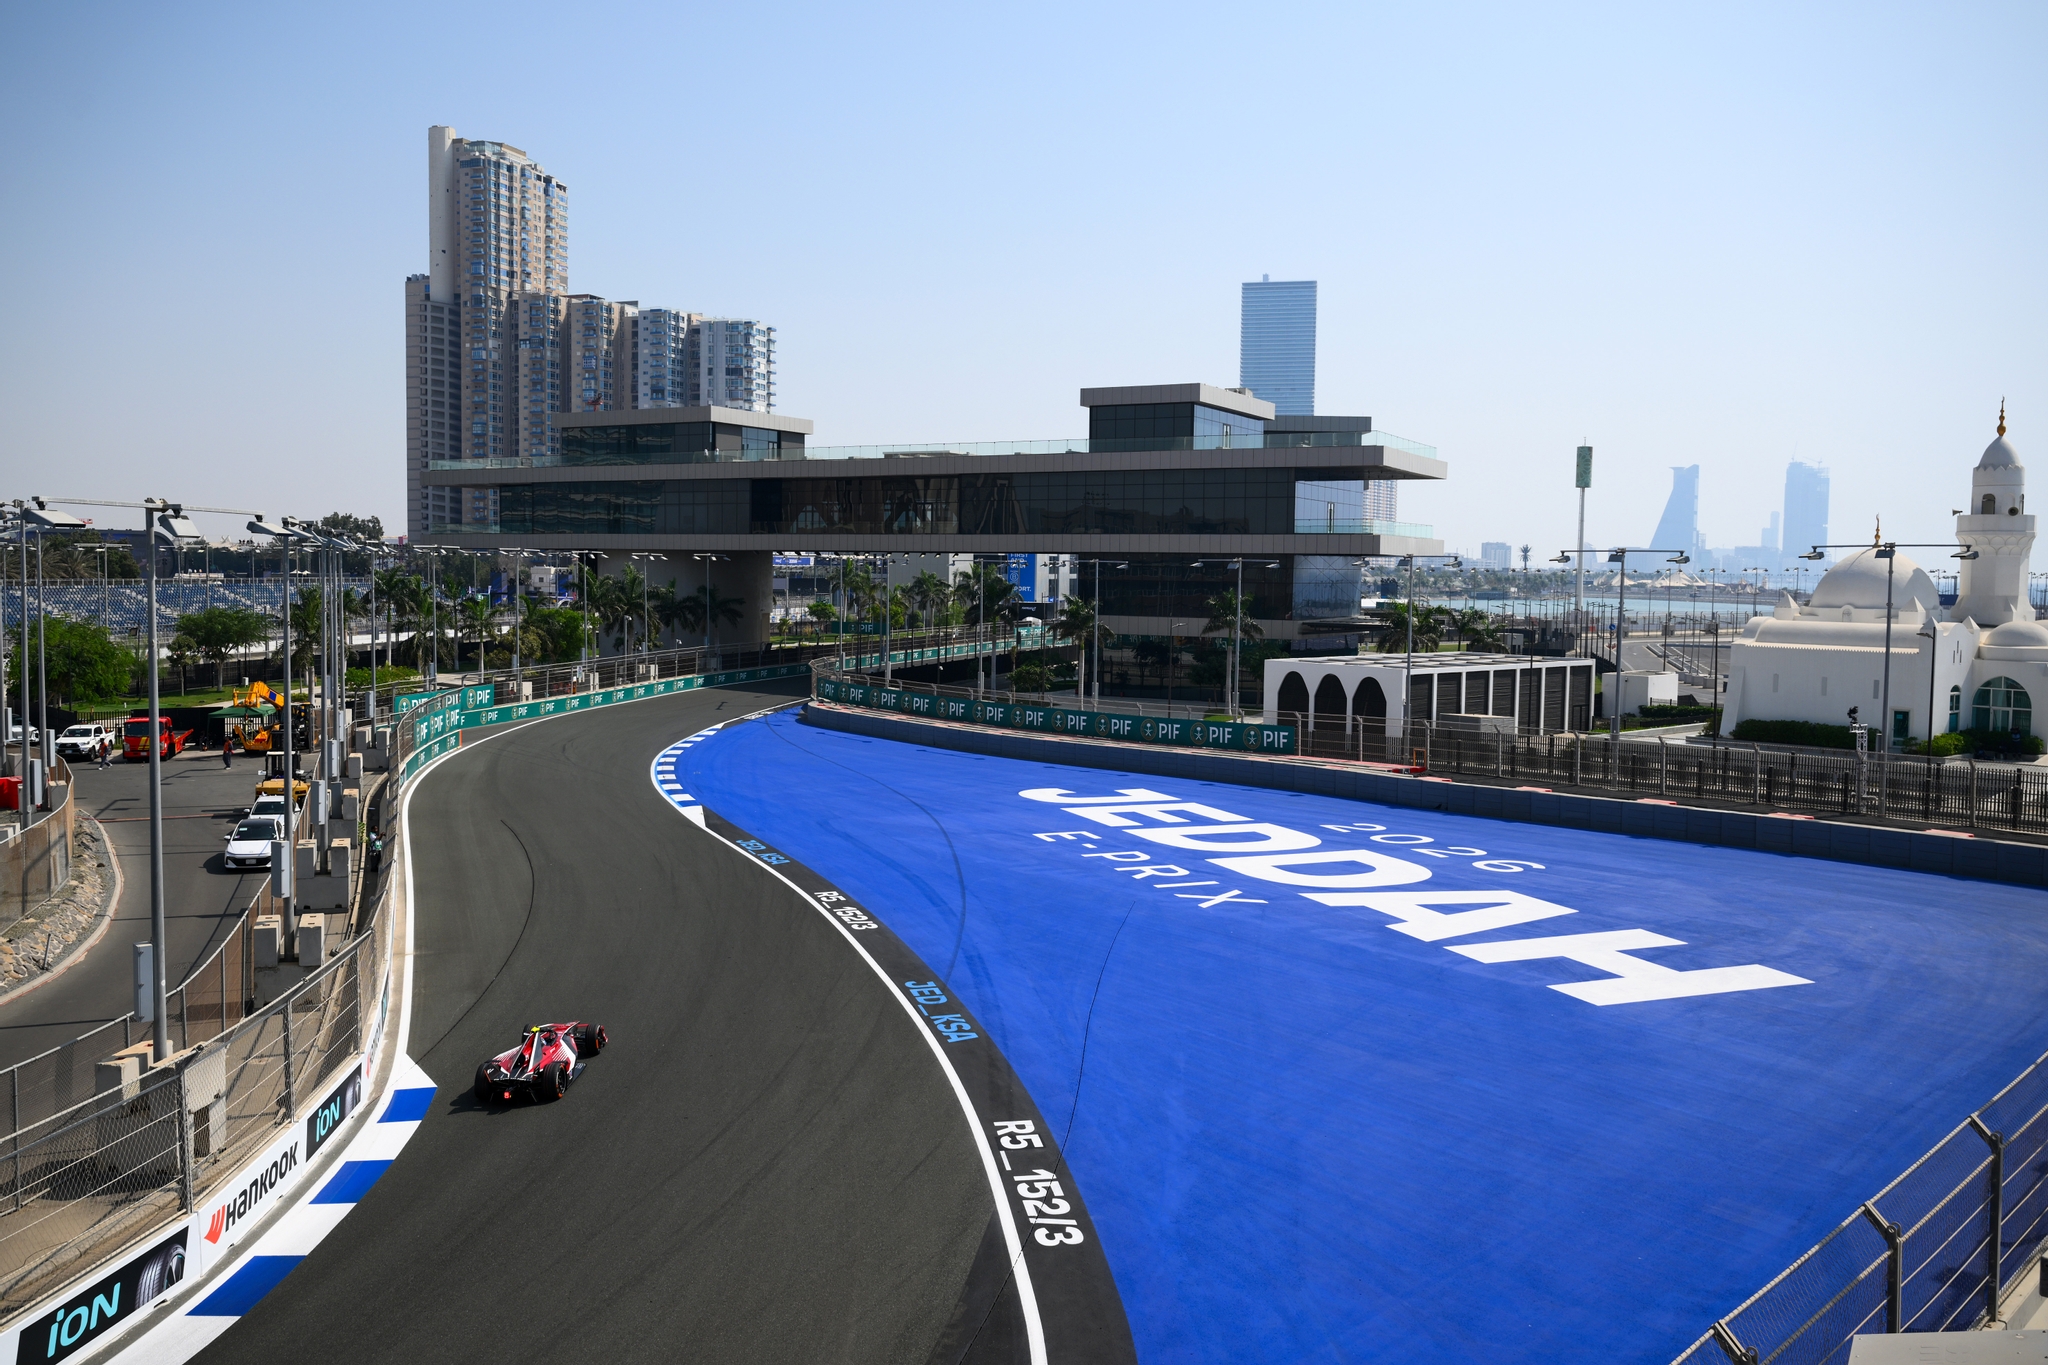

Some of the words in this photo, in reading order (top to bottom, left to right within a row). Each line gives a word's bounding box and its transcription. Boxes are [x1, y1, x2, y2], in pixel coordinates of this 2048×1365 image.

[450, 708, 459, 727] PIF
[476, 689, 491, 705] PIF
[487, 711, 499, 722] PIF
[518, 707, 528, 716] PIF
[545, 703, 555, 712] PIF
[571, 699, 580, 708] PIF
[594, 695, 603, 703] PIF
[617, 691, 625, 700] PIF
[824, 683, 835, 696] PIF
[849, 688, 864, 701] PIF
[881, 692, 897, 707] PIF
[913, 698, 930, 712] PIF
[949, 702, 966, 717] PIF
[986, 706, 1005, 721] PIF
[1025, 710, 1044, 726] PIF
[1067, 715, 1087, 731] PIF
[1111, 719, 1132, 735] PIF
[1158, 723, 1180, 740] PIF
[1209, 726, 1233, 744] PIF
[1263, 730, 1289, 749] PIF
[1032, 831, 1269, 908] E-PRIX
[1319, 823, 1546, 872] 2026
[814, 890, 878, 930] R5_152/3
[1018, 788, 1815, 1006] JEDDAH
[904, 980, 978, 1043] JED_KSA
[993, 1120, 1084, 1247] R5_152/3
